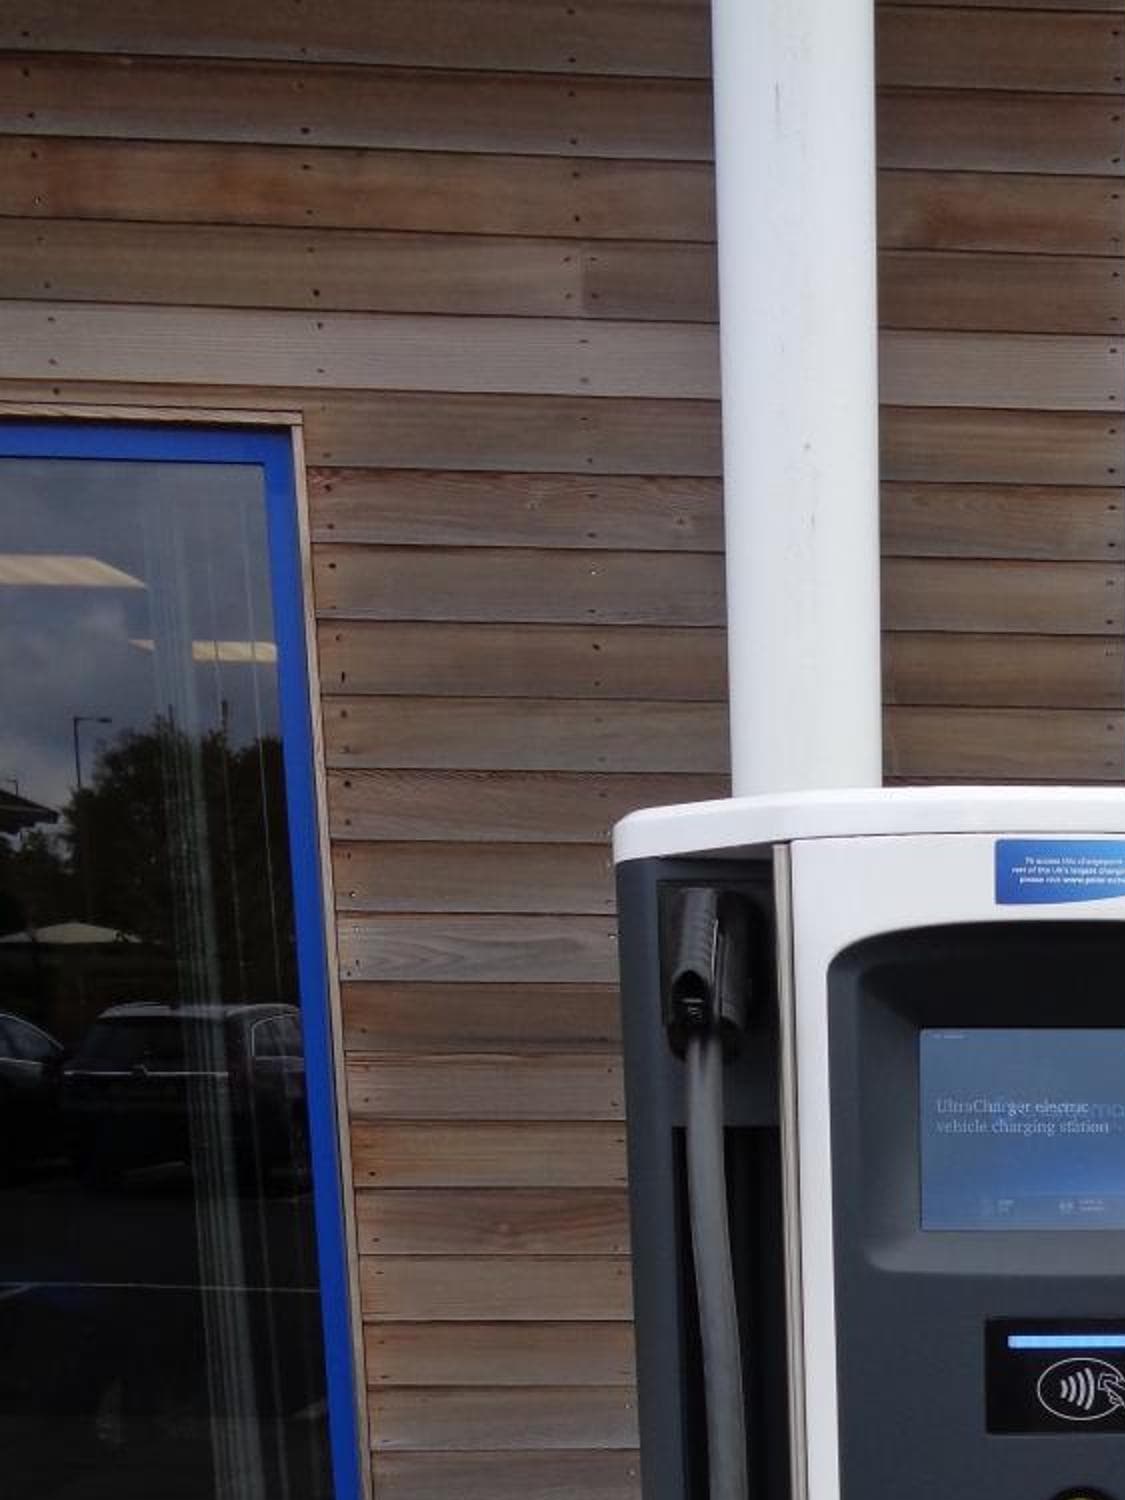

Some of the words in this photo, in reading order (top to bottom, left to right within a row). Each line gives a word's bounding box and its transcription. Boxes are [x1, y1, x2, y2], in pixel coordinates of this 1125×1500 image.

[1035, 1099, 1088, 1113] electric
[937, 1119, 986, 1133] vehicle
[991, 1119, 1055, 1136] charging
[1060, 1119, 1109, 1134] station
